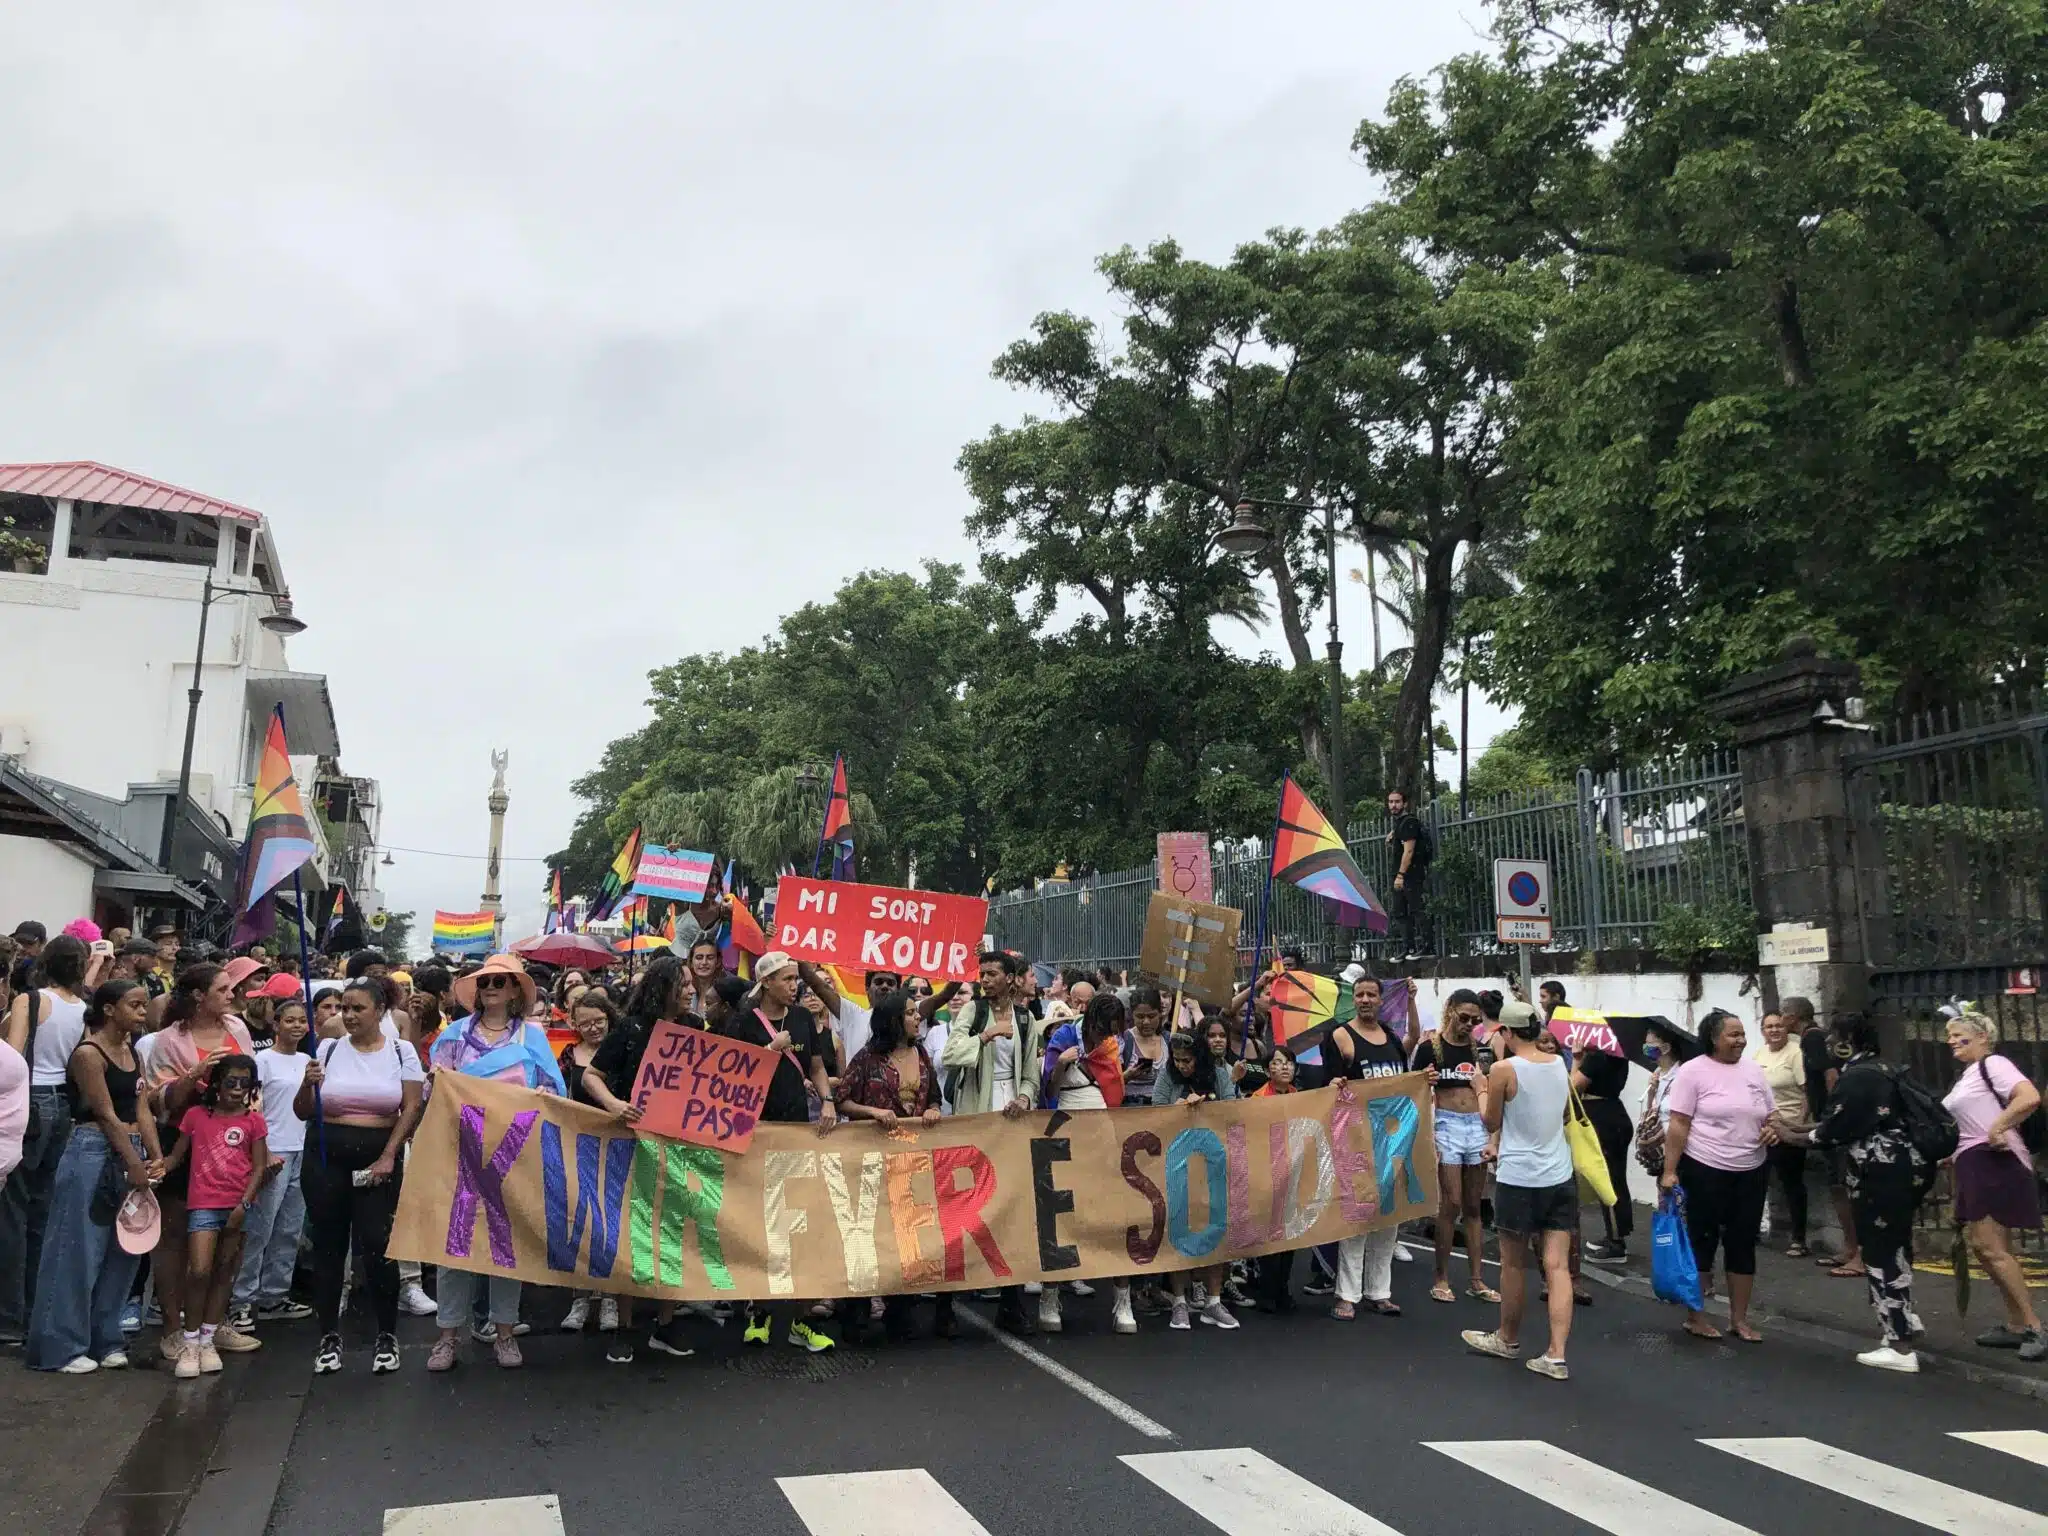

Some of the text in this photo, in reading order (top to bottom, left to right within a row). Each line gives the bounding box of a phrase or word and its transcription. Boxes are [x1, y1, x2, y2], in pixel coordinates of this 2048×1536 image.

[798, 888, 937, 925] MI SORT
[1509, 931, 1544, 940] ORANGE
[1514, 922, 1536, 930] ZONE
[781, 924, 968, 976] DAR KOUR
[642, 1062, 682, 1090] NE
[681, 1099, 734, 1141] PAS
[445, 1103, 736, 1290] KWIR
